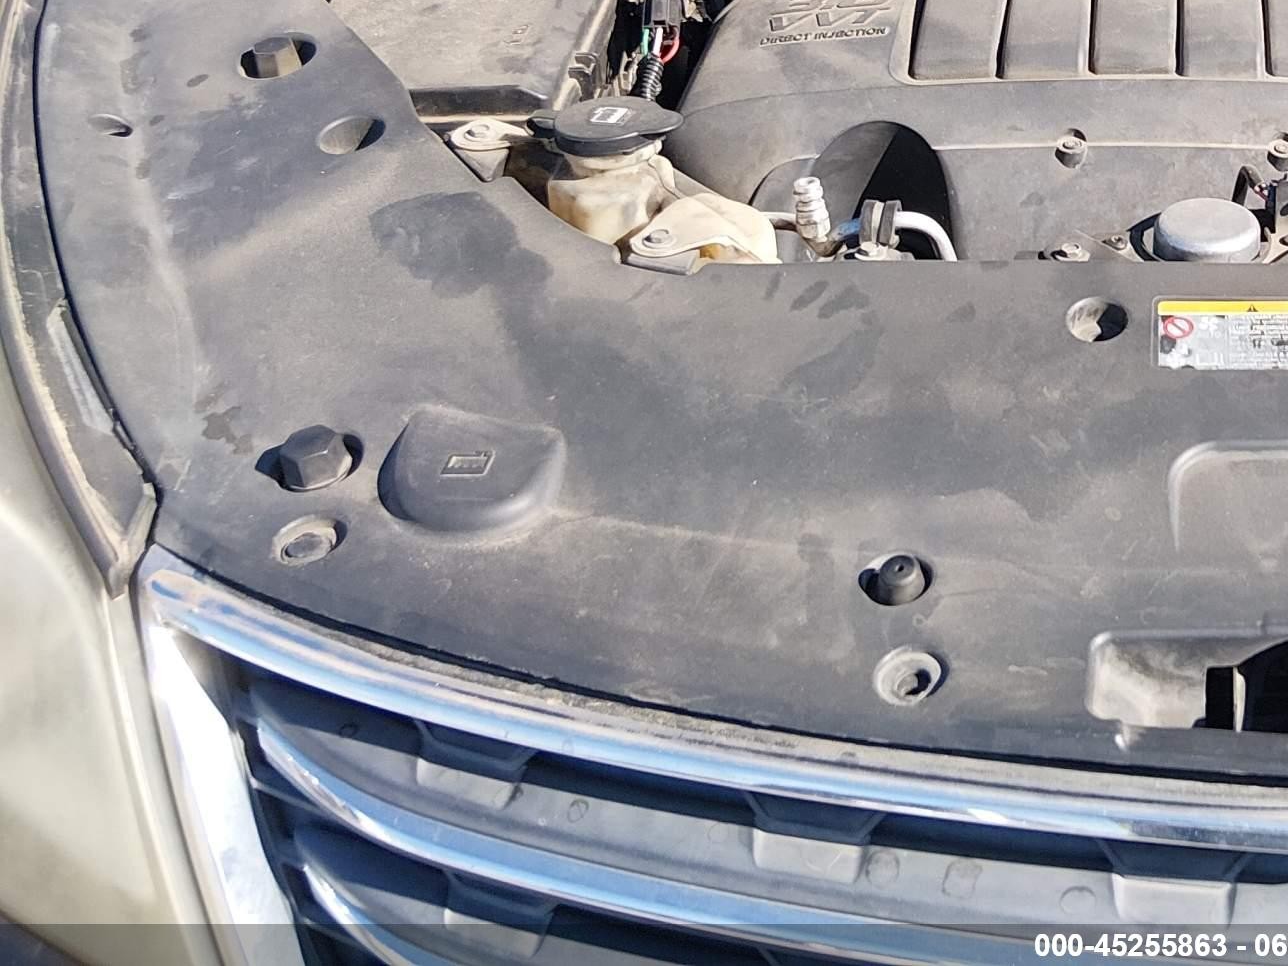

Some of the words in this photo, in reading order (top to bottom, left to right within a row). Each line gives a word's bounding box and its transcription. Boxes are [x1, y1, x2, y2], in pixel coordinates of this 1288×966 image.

[768, 6, 892, 32] VVT
[759, 32, 811, 46] DIRECT
[813, 26, 886, 41] INJECTION
